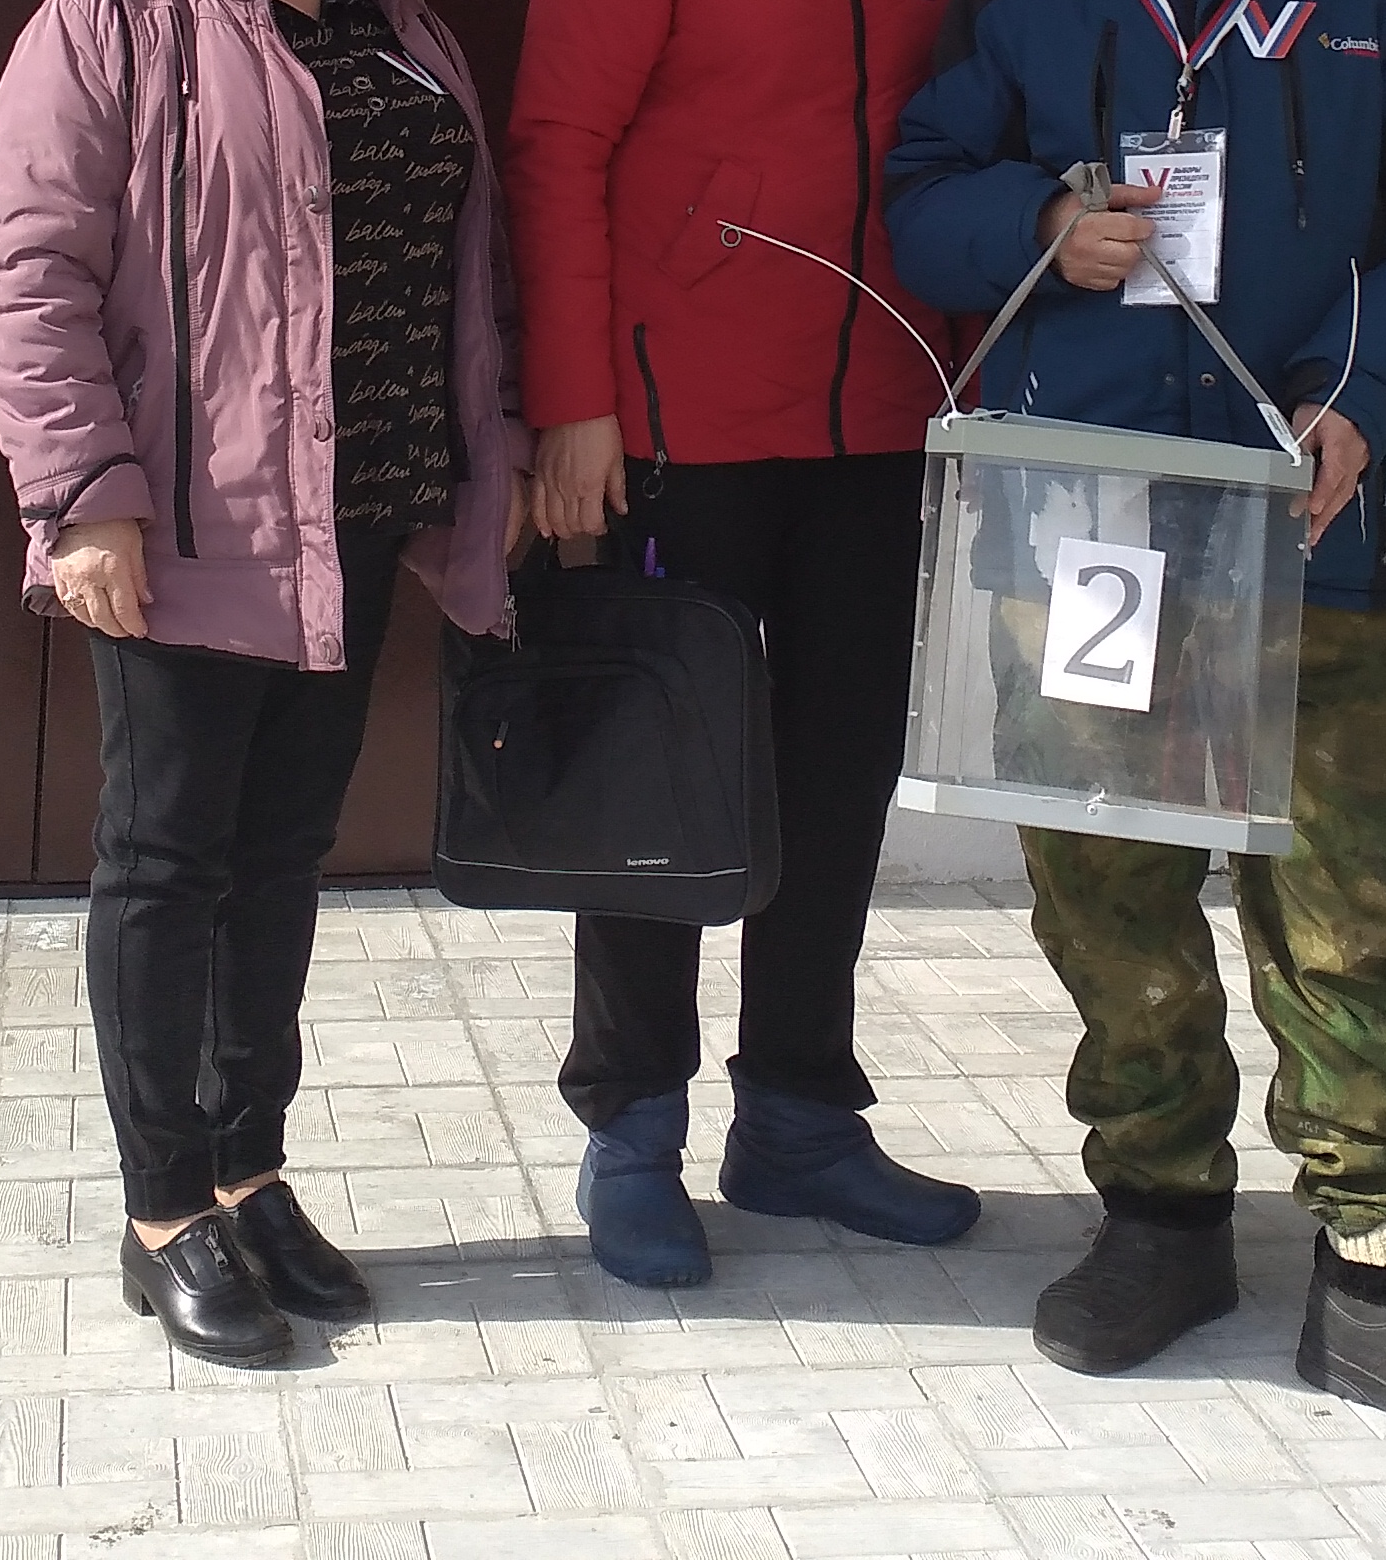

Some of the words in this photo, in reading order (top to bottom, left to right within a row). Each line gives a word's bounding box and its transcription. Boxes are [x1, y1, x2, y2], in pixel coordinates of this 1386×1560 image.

[1330, 36, 1379, 51] Columbi
[1063, 564, 1143, 685] 2
[627, 857, 669, 867] lenovo
